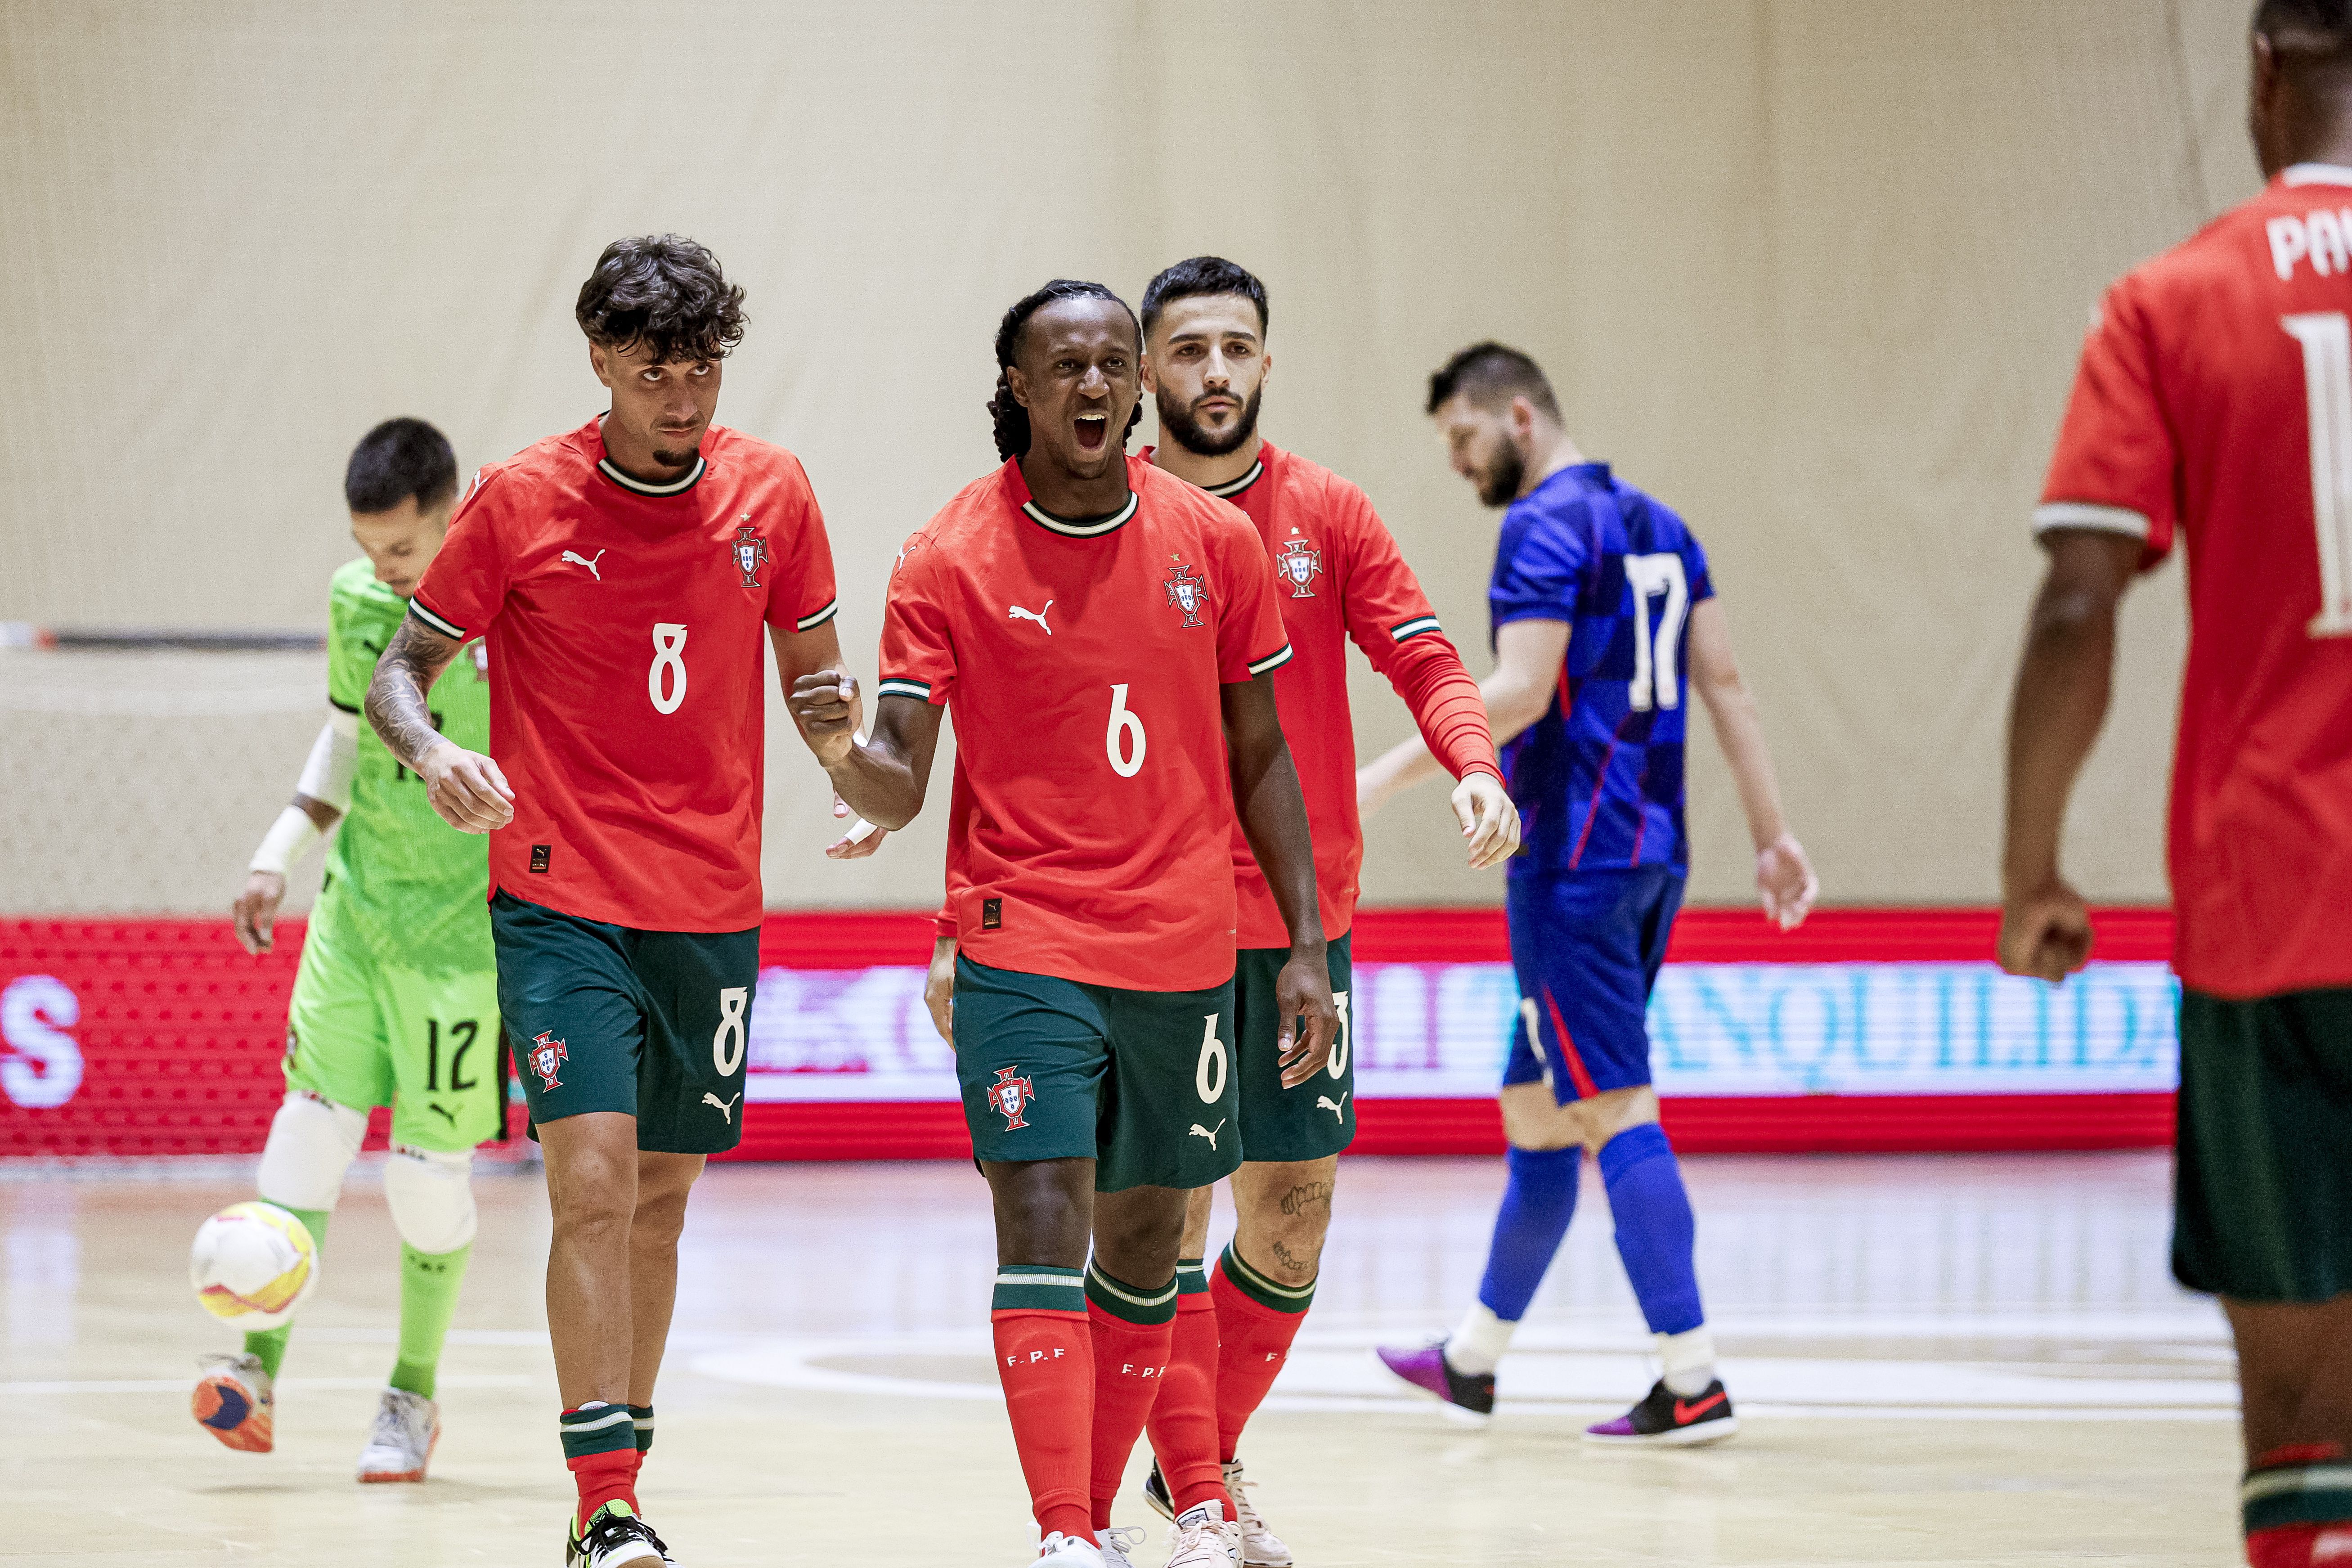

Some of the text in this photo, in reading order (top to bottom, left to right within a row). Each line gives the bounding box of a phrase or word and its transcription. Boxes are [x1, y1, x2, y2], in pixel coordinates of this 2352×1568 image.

[649, 623, 688, 714] 8
[1623, 552, 1690, 712] 17
[1106, 683, 1147, 777] 6
[427, 1019, 480, 1092] 12
[714, 987, 747, 1077] 8
[1196, 1013, 1227, 1104] 6
